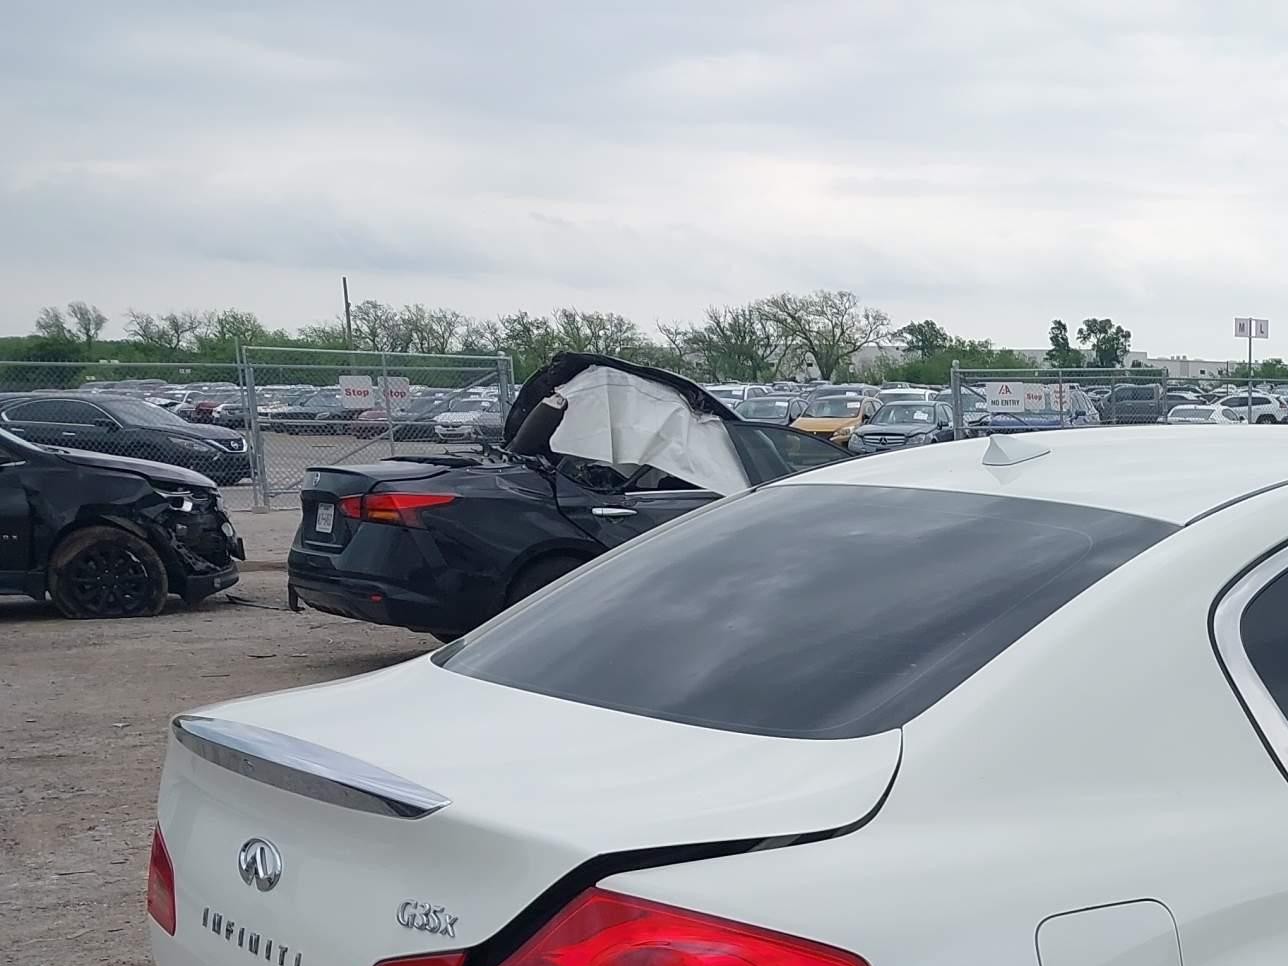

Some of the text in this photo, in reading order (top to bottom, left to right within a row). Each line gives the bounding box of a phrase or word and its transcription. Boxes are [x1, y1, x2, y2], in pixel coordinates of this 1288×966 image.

[1238, 322, 1246, 333] M
[344, 388, 370, 397] Stop
[1026, 393, 1043, 401] Stop
[1001, 400, 1020, 408] ENTRY
